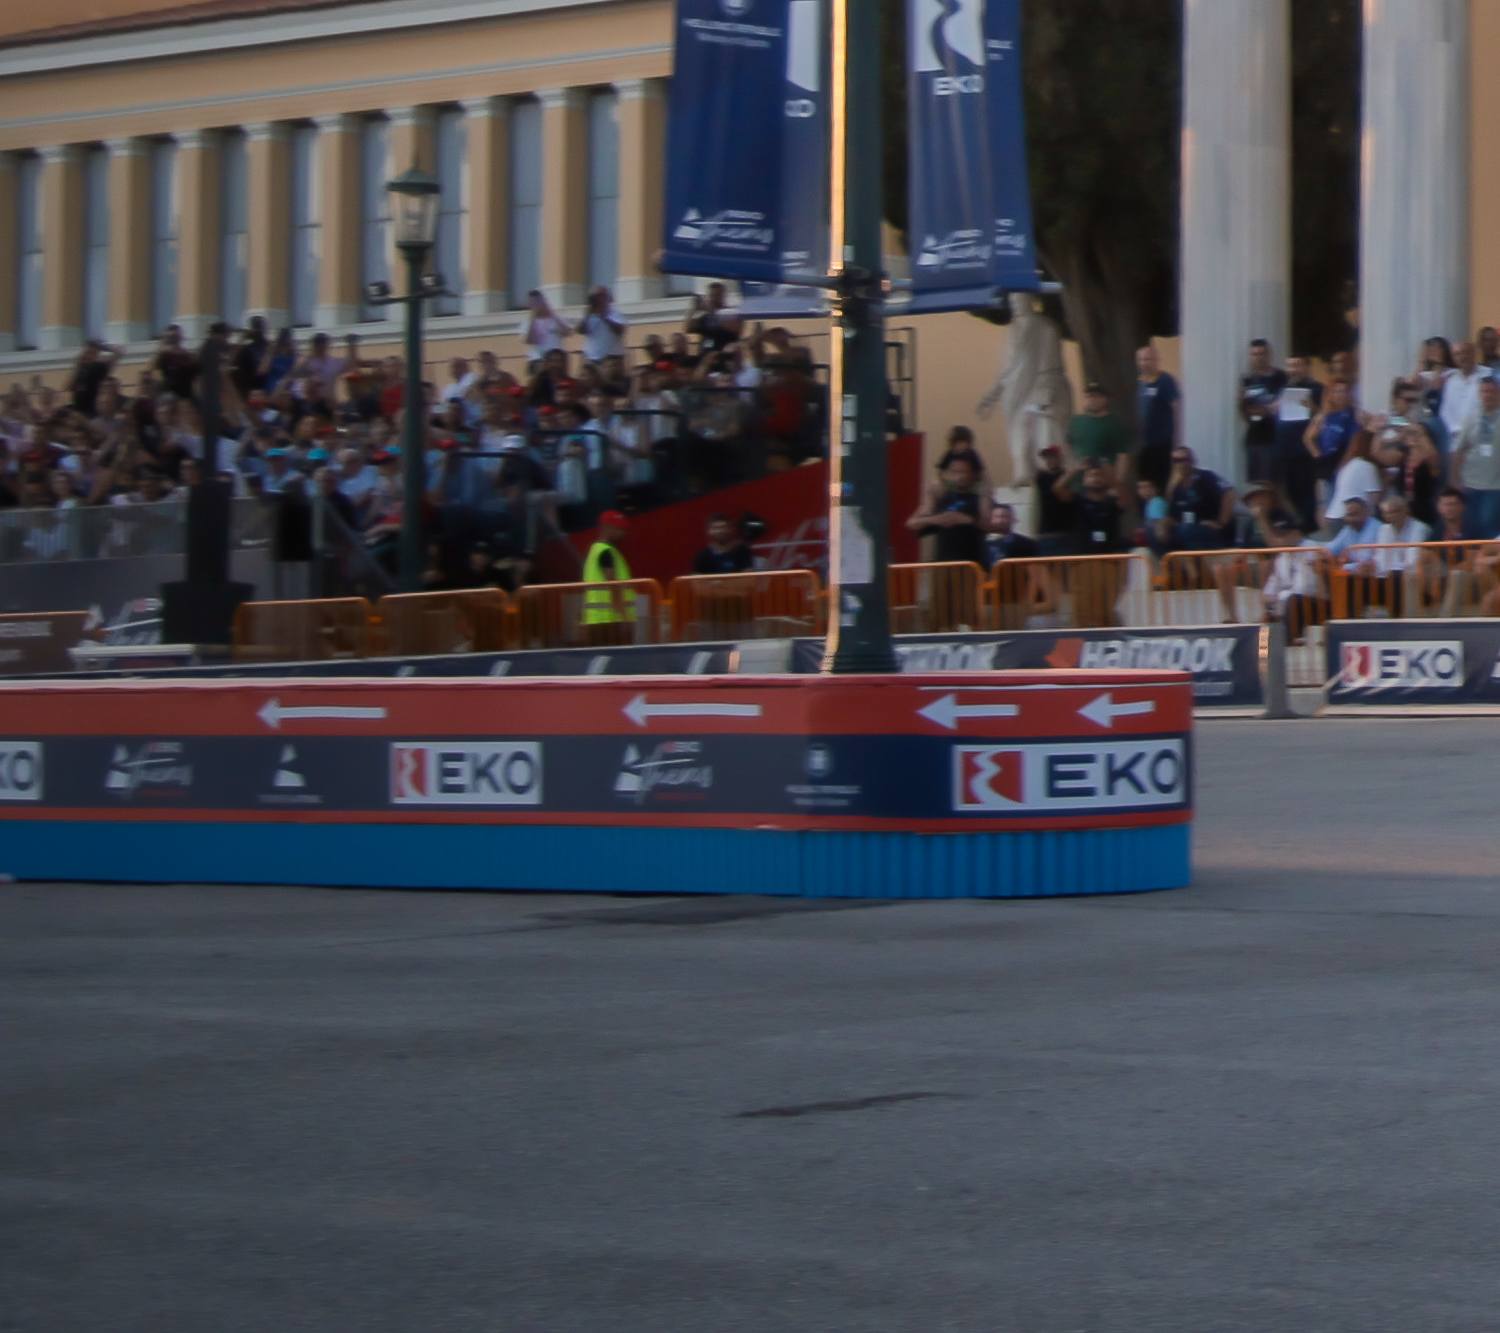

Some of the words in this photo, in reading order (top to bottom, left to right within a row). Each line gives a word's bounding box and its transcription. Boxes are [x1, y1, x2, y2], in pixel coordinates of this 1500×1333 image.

[1379, 647, 1457, 679] EKO
[438, 751, 536, 794] EKO
[1045, 747, 1180, 799] EKO
